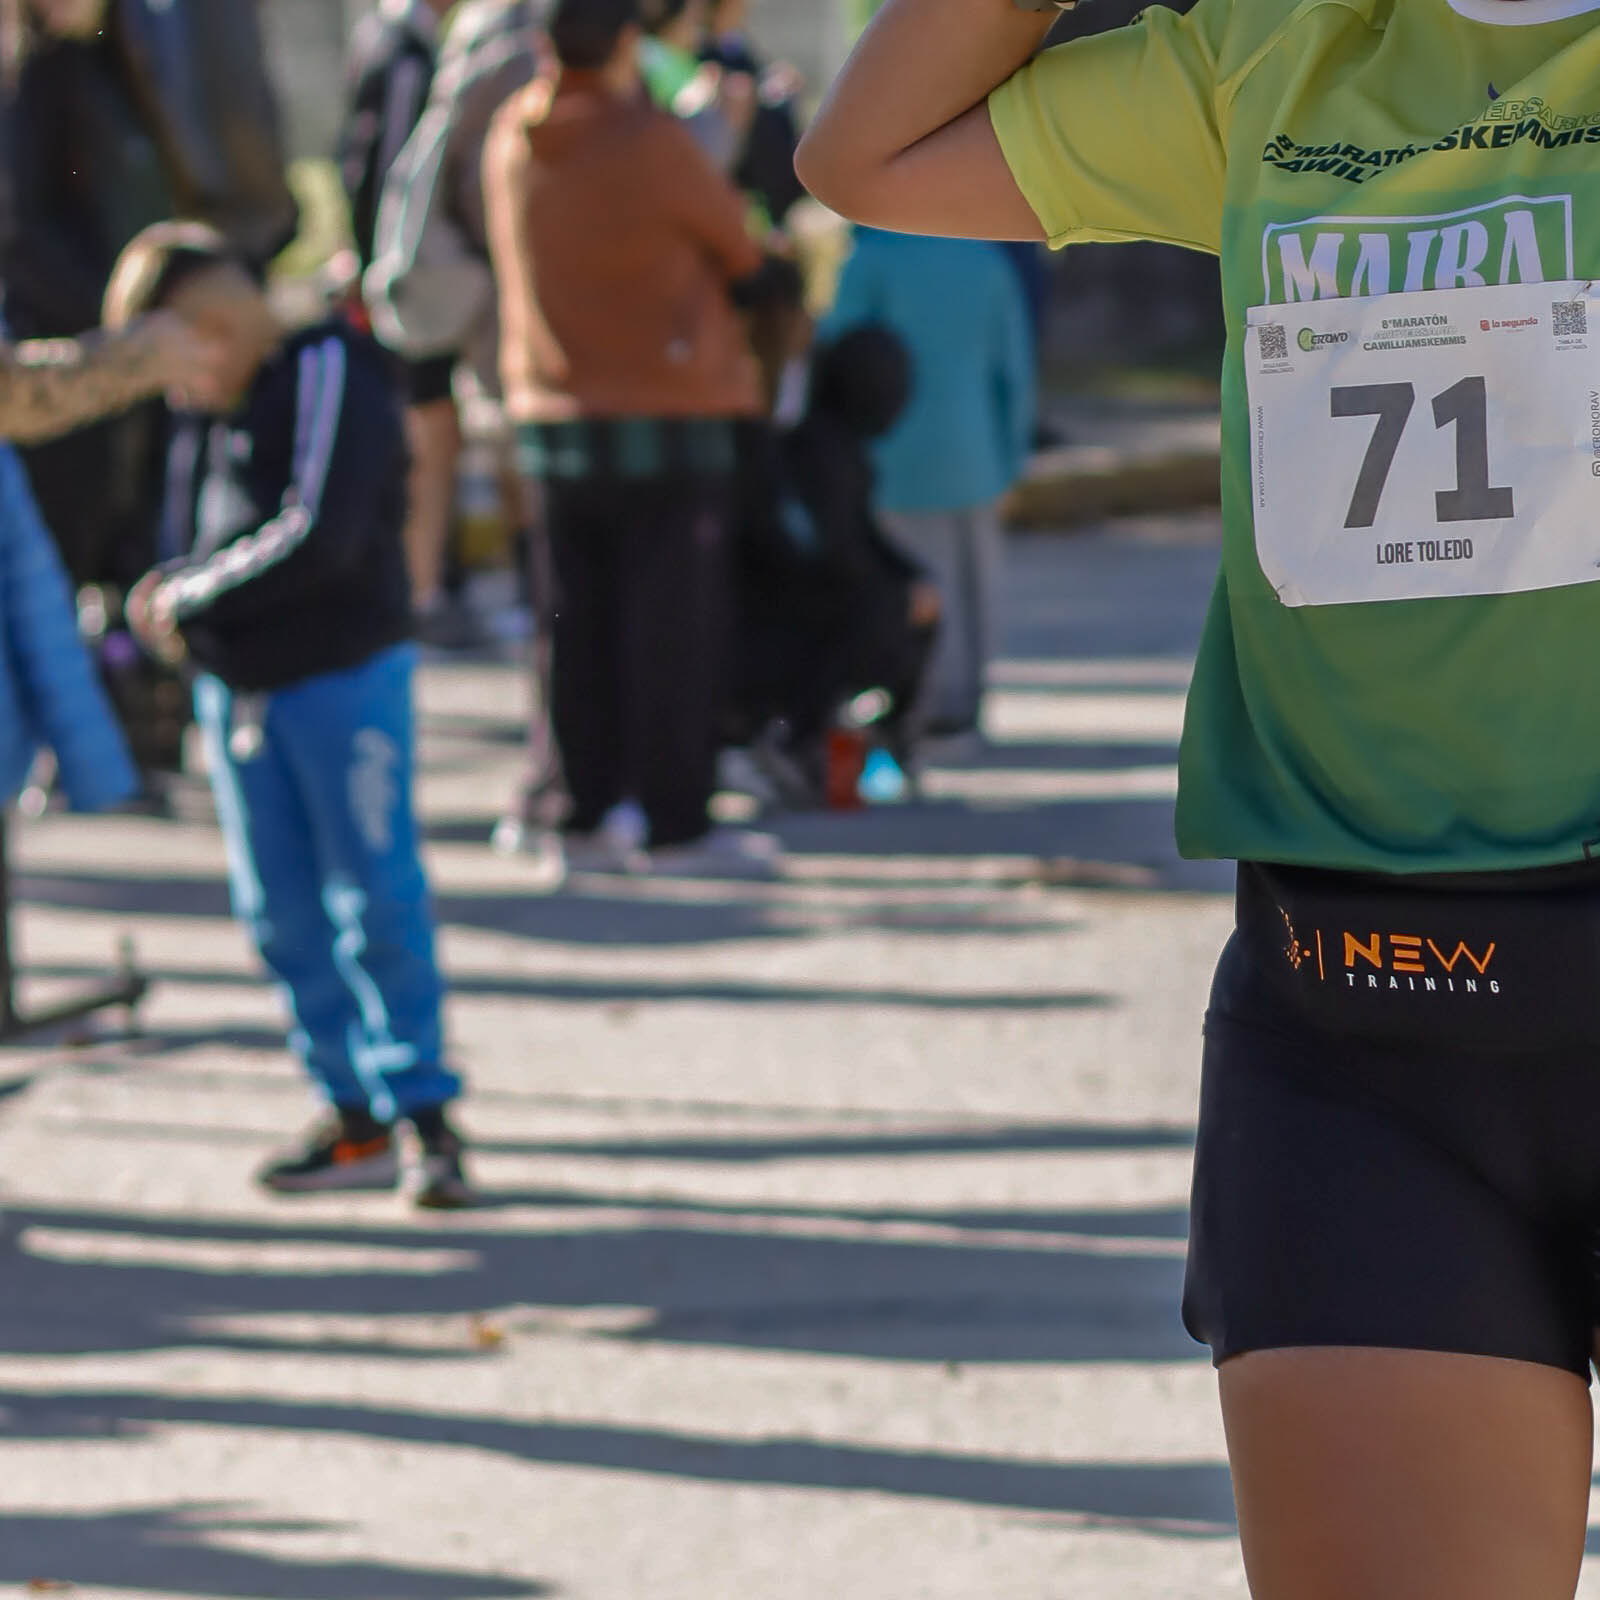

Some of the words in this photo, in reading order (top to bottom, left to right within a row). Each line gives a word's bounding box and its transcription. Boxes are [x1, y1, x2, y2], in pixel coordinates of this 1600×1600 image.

[1330, 375, 1515, 529] 71
[1376, 541, 1415, 565] LORE
[1417, 538, 1474, 563] TOLEDO
[1343, 931, 1496, 975] NEW
[1346, 972, 1500, 994] TRAINING
